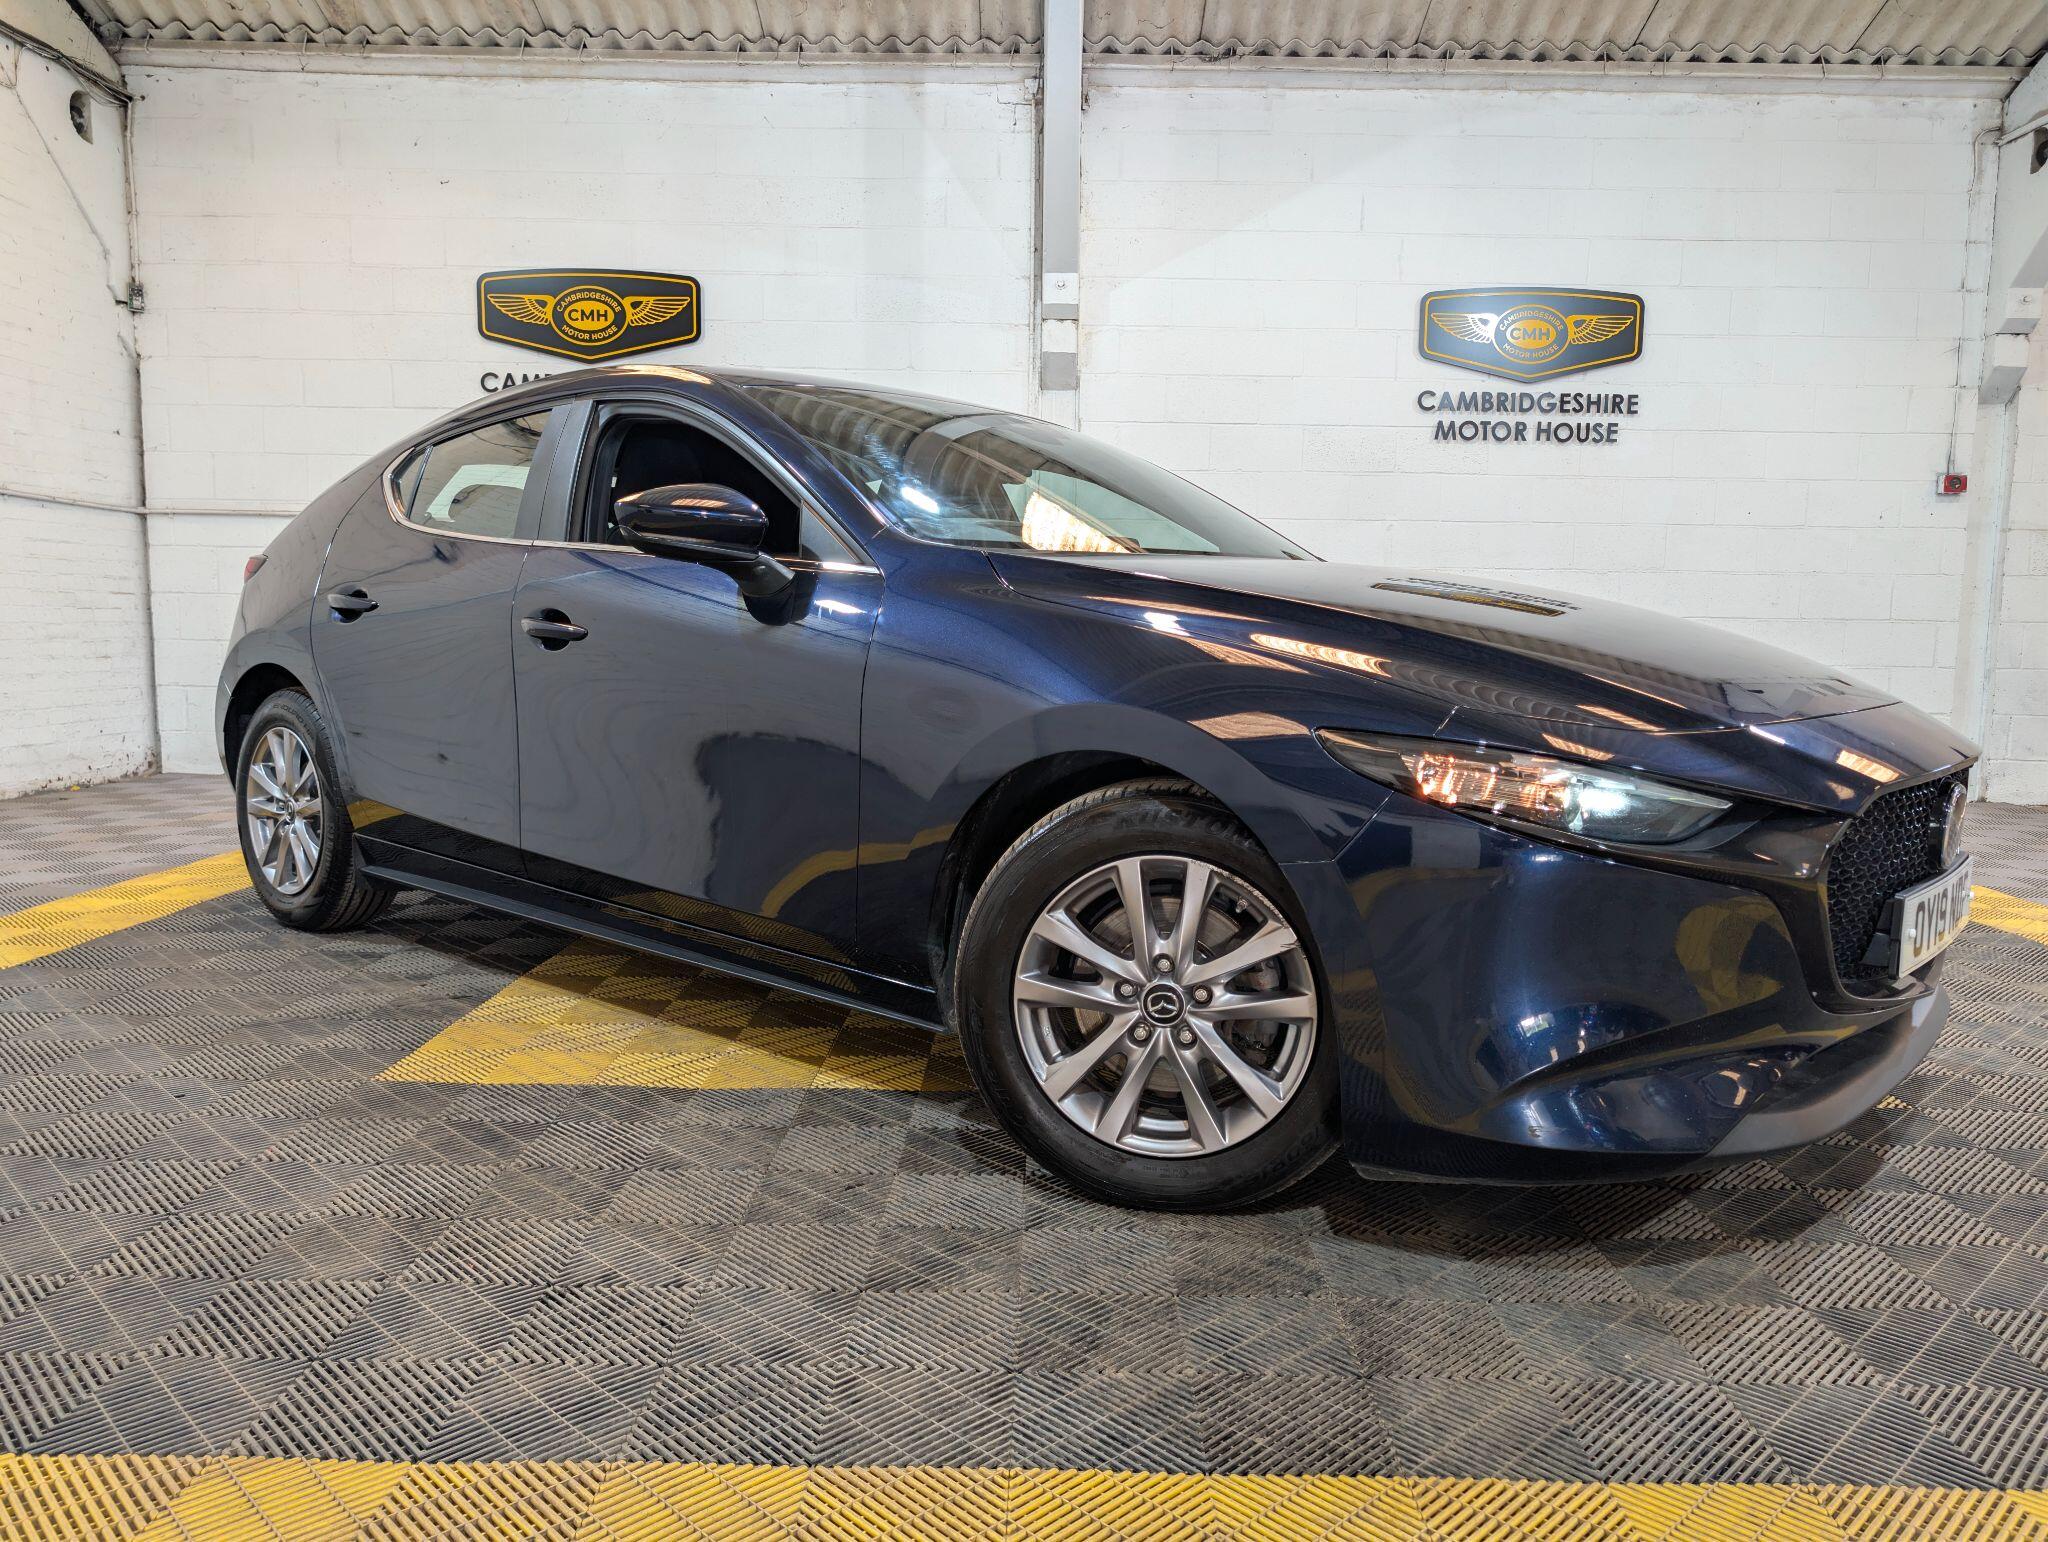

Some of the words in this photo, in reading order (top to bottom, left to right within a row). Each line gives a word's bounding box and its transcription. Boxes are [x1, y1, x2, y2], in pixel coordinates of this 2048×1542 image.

[556, 291, 622, 313] CAMBRIDGESHIRE
[568, 308, 608, 322] CMH
[1500, 310, 1564, 331] CAMBRIDGESHIRE
[562, 325, 590, 340] MOTOR
[592, 325, 618, 340] HOUSE
[1510, 327, 1551, 341] CMH
[1503, 343, 1530, 358] MOTOR
[1533, 344, 1559, 359] HOUSE
[1417, 390, 1639, 415] CAMBRIDGESHIRE
[1434, 420, 1528, 442] MOTOR
[1536, 421, 1619, 443] HOUSE
